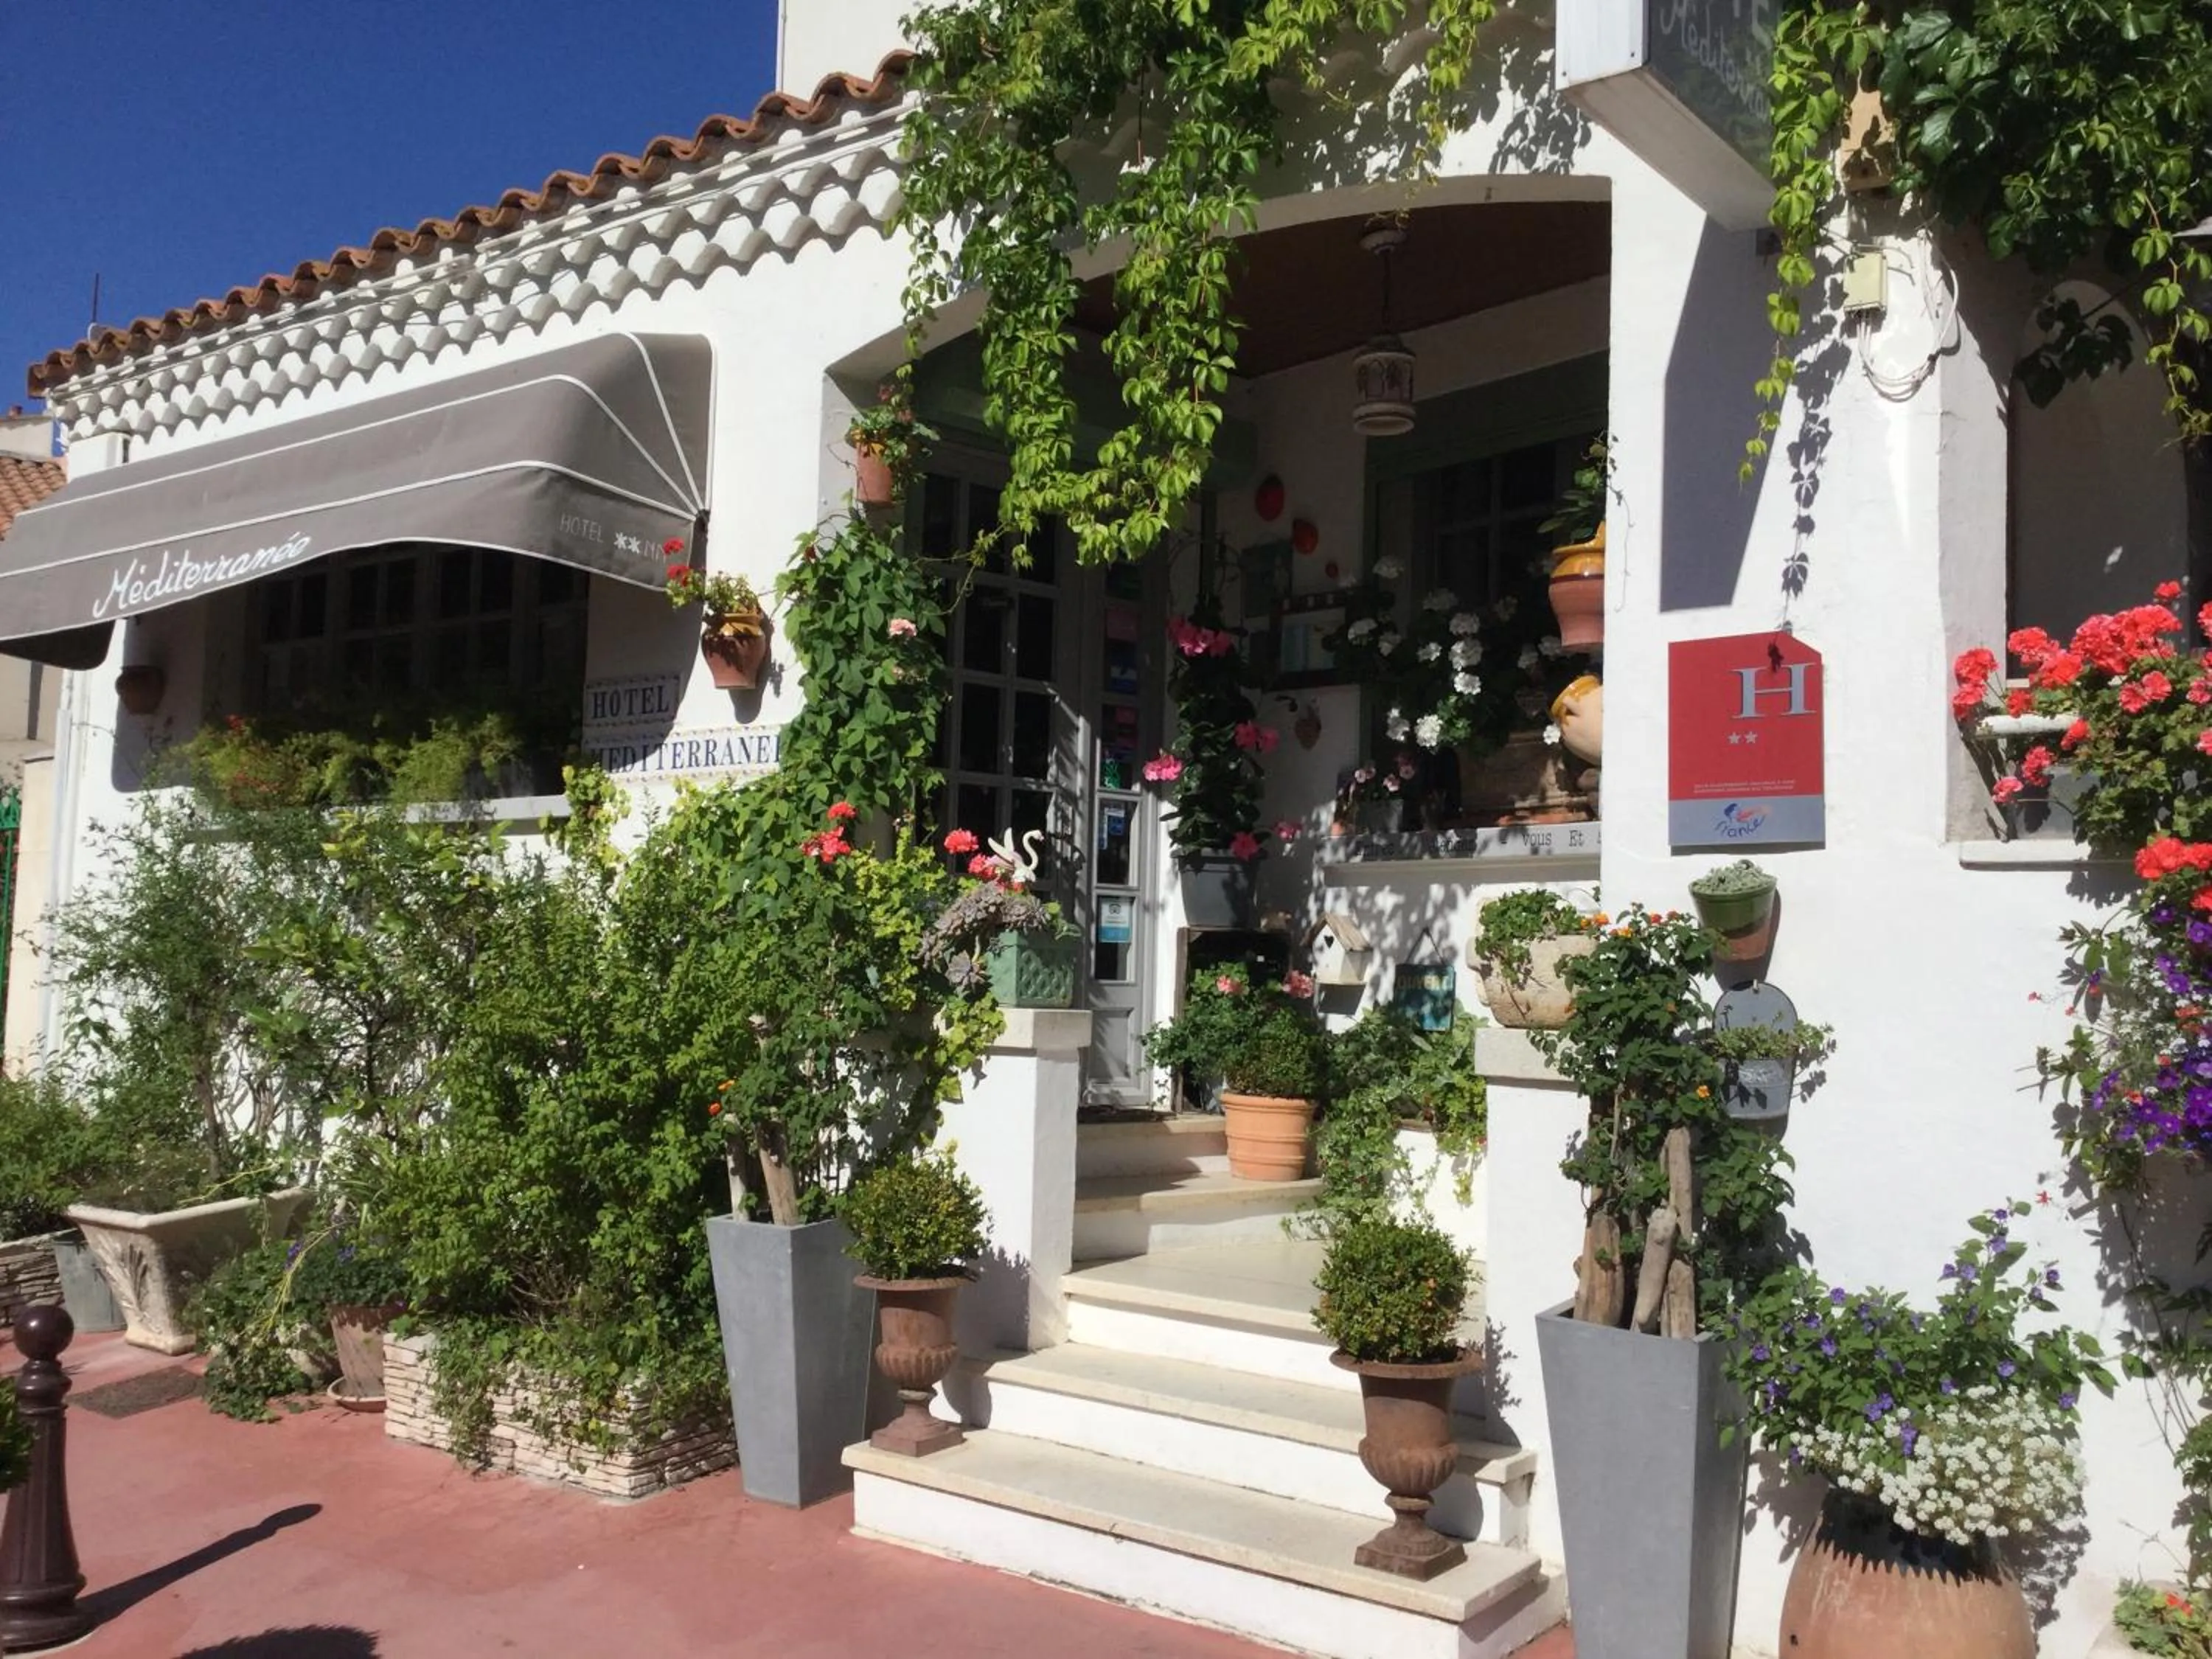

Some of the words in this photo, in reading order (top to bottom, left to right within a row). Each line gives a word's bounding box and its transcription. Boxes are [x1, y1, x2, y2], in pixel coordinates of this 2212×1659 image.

[559, 514, 604, 543] HOTEL
[1729, 663, 1817, 719] H
[1522, 832, 1553, 847] vous
[1568, 830, 1585, 847] Et
